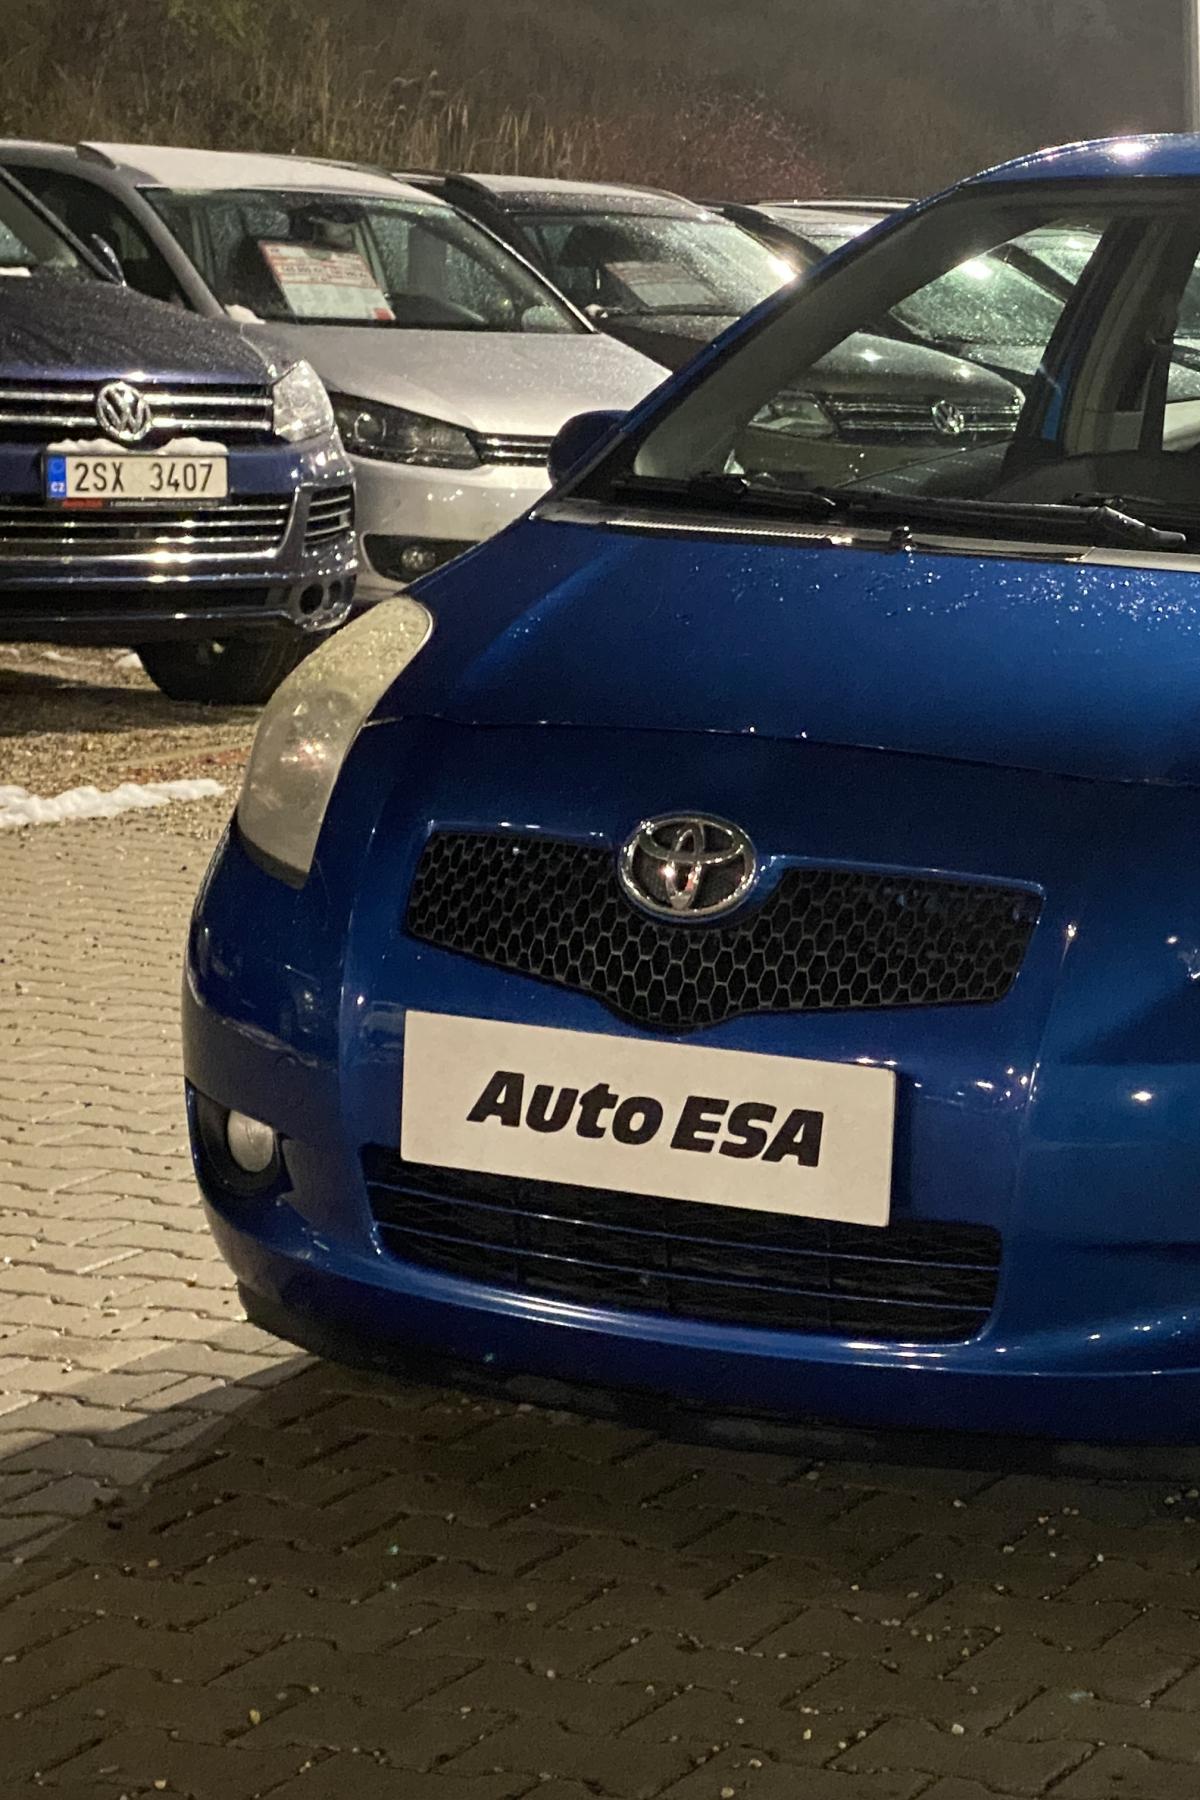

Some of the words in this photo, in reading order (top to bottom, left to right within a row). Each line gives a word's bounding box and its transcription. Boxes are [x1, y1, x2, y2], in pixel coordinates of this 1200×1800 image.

[51, 482, 65, 493] CZ
[74, 461, 125, 493] 2SX
[149, 461, 214, 493] 3407
[466, 1070, 664, 1145] Auto
[670, 1095, 825, 1168] ESA
